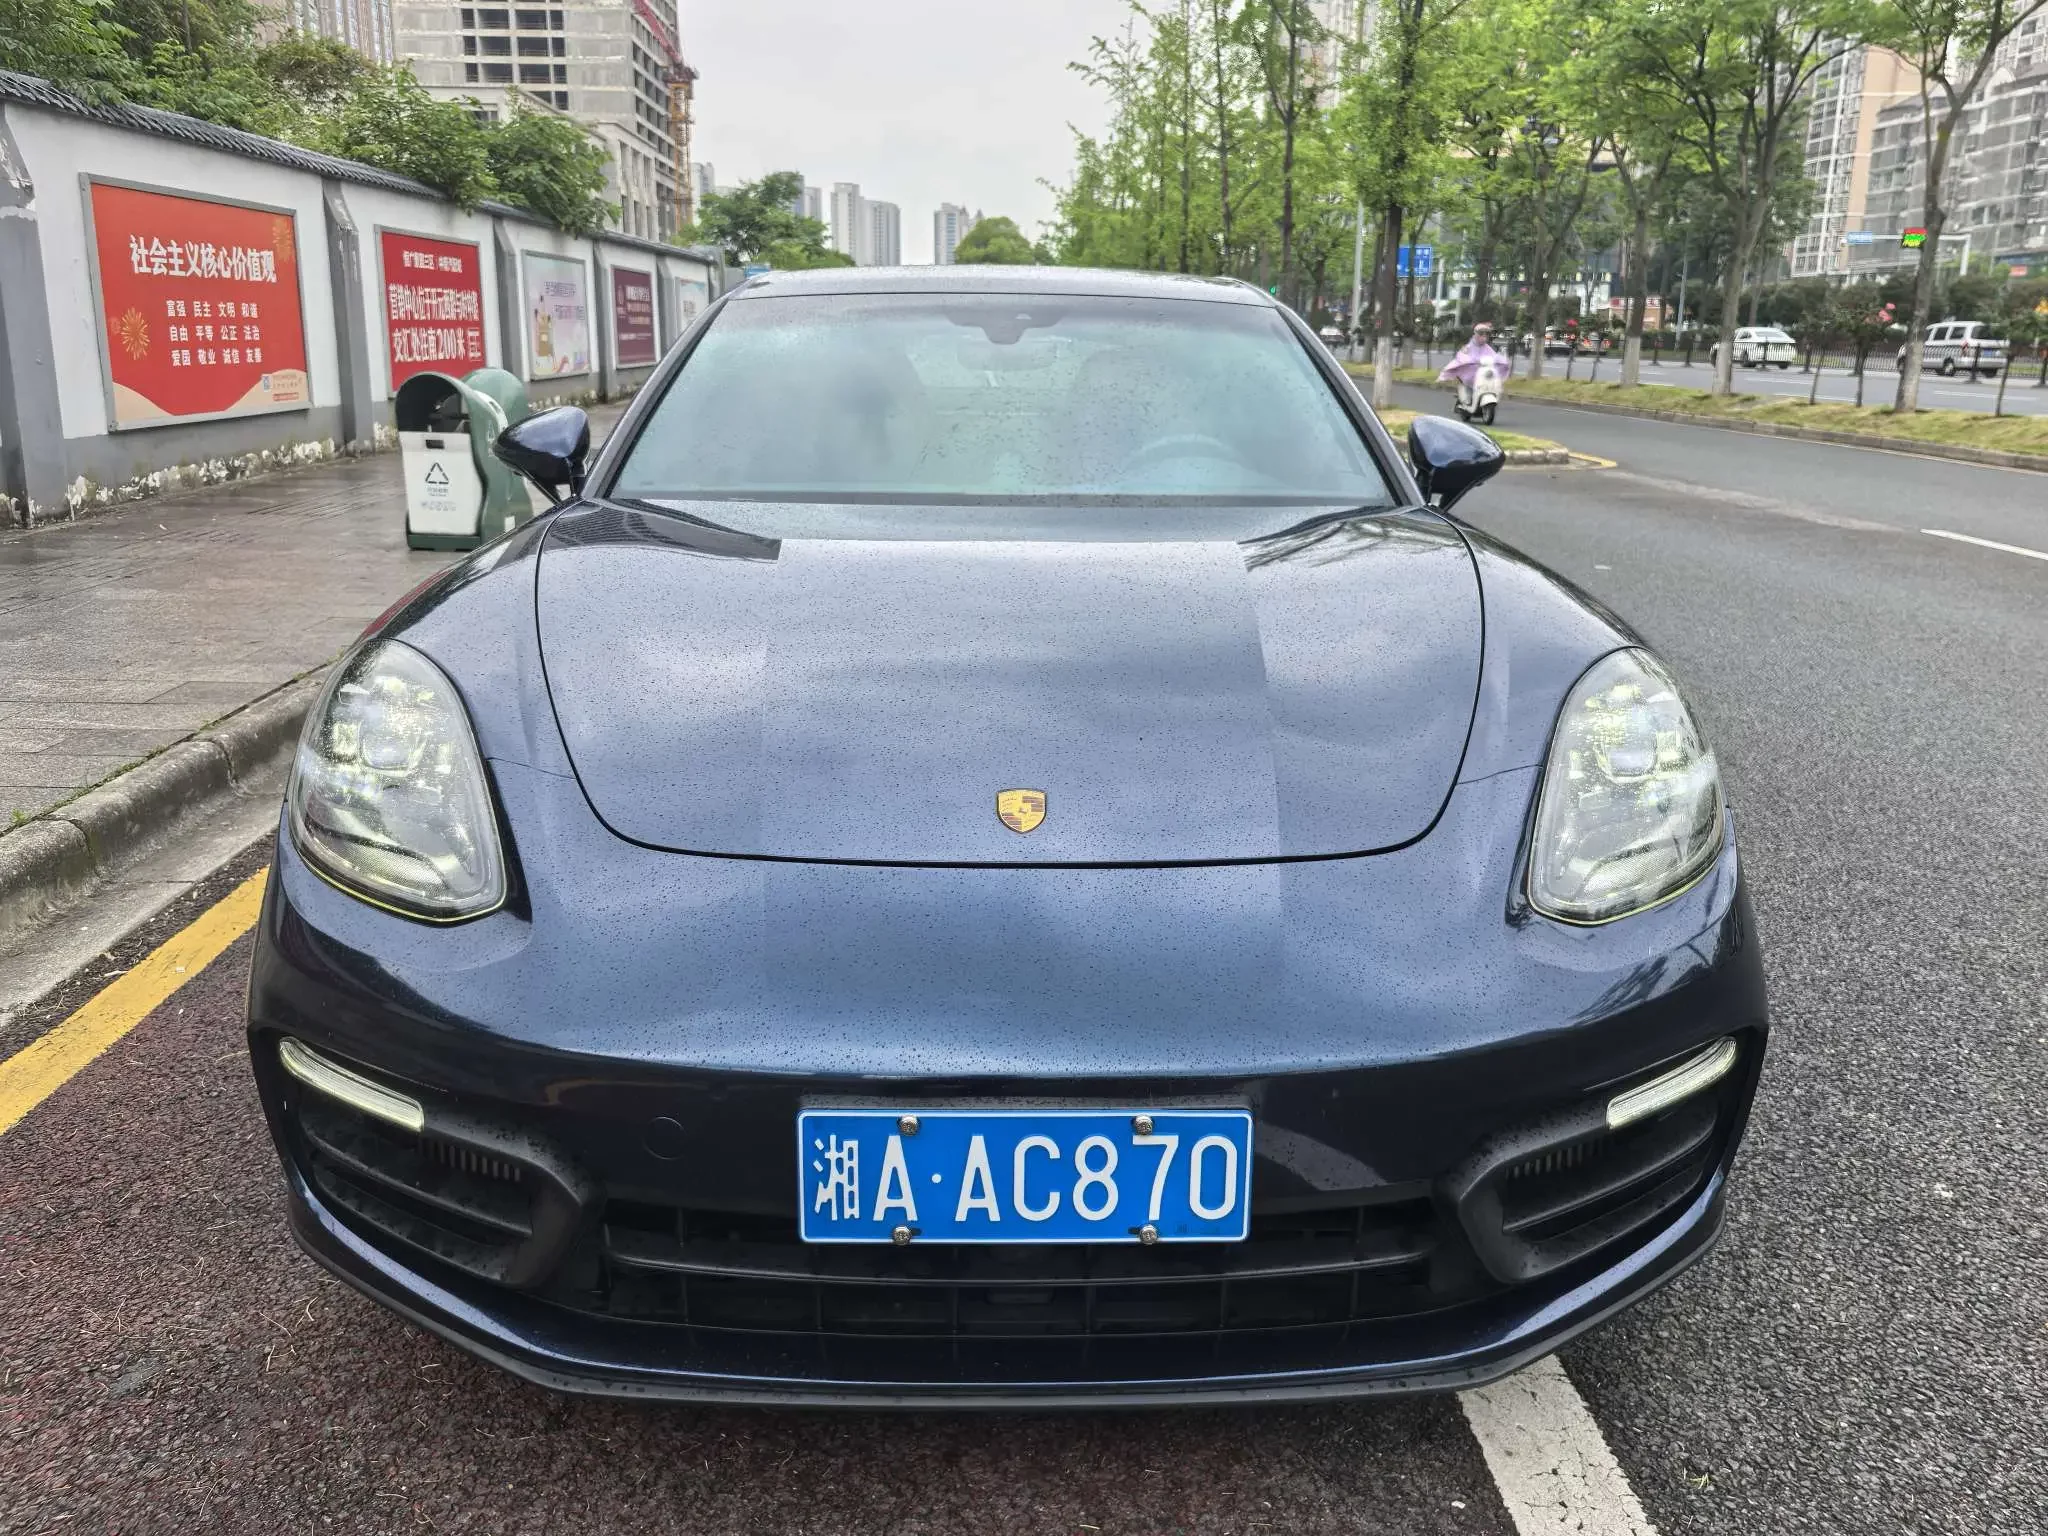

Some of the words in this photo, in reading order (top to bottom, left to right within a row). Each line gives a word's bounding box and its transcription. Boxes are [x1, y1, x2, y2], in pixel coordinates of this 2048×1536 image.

[129, 234, 277, 283] 社会主义核心价值观
[166, 300, 187, 317] 富强
[193, 301, 212, 318] 民主
[218, 302, 236, 318] 文明
[241, 303, 258, 319] 和谐
[169, 325, 189, 342] 自由
[195, 325, 214, 341] 平等
[220, 325, 238, 341] 公正
[243, 325, 260, 341] 法治
[392, 327, 466, 363] 交汇处往南200米
[171, 349, 192, 367] 爱国
[198, 348, 216, 365] 敬业
[222, 347, 240, 364] 诚信
[245, 346, 262, 363] 友善
